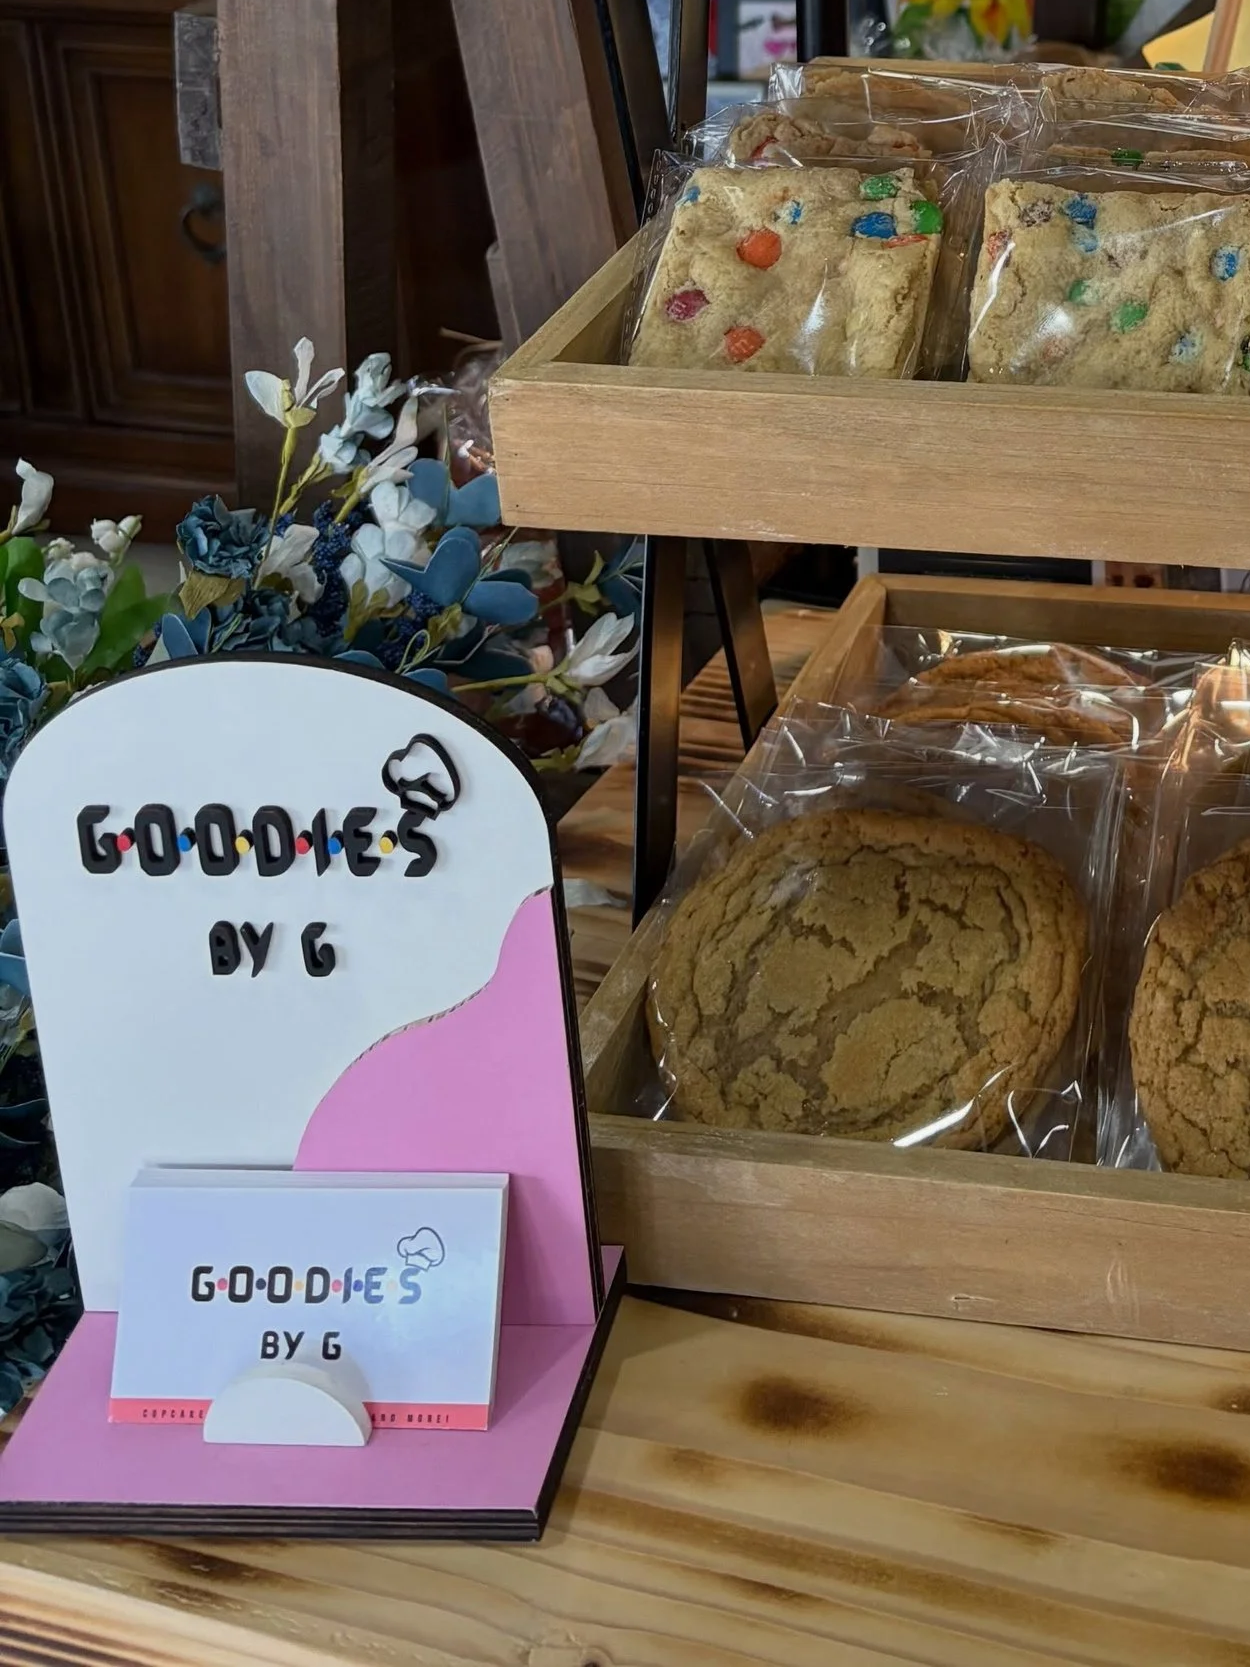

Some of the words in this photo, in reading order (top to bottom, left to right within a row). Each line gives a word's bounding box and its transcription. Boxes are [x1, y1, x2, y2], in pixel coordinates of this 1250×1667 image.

[208, 919, 275, 979] BY
[301, 921, 337, 978] G
[260, 1330, 305, 1360] BY
[322, 1331, 342, 1361] G
